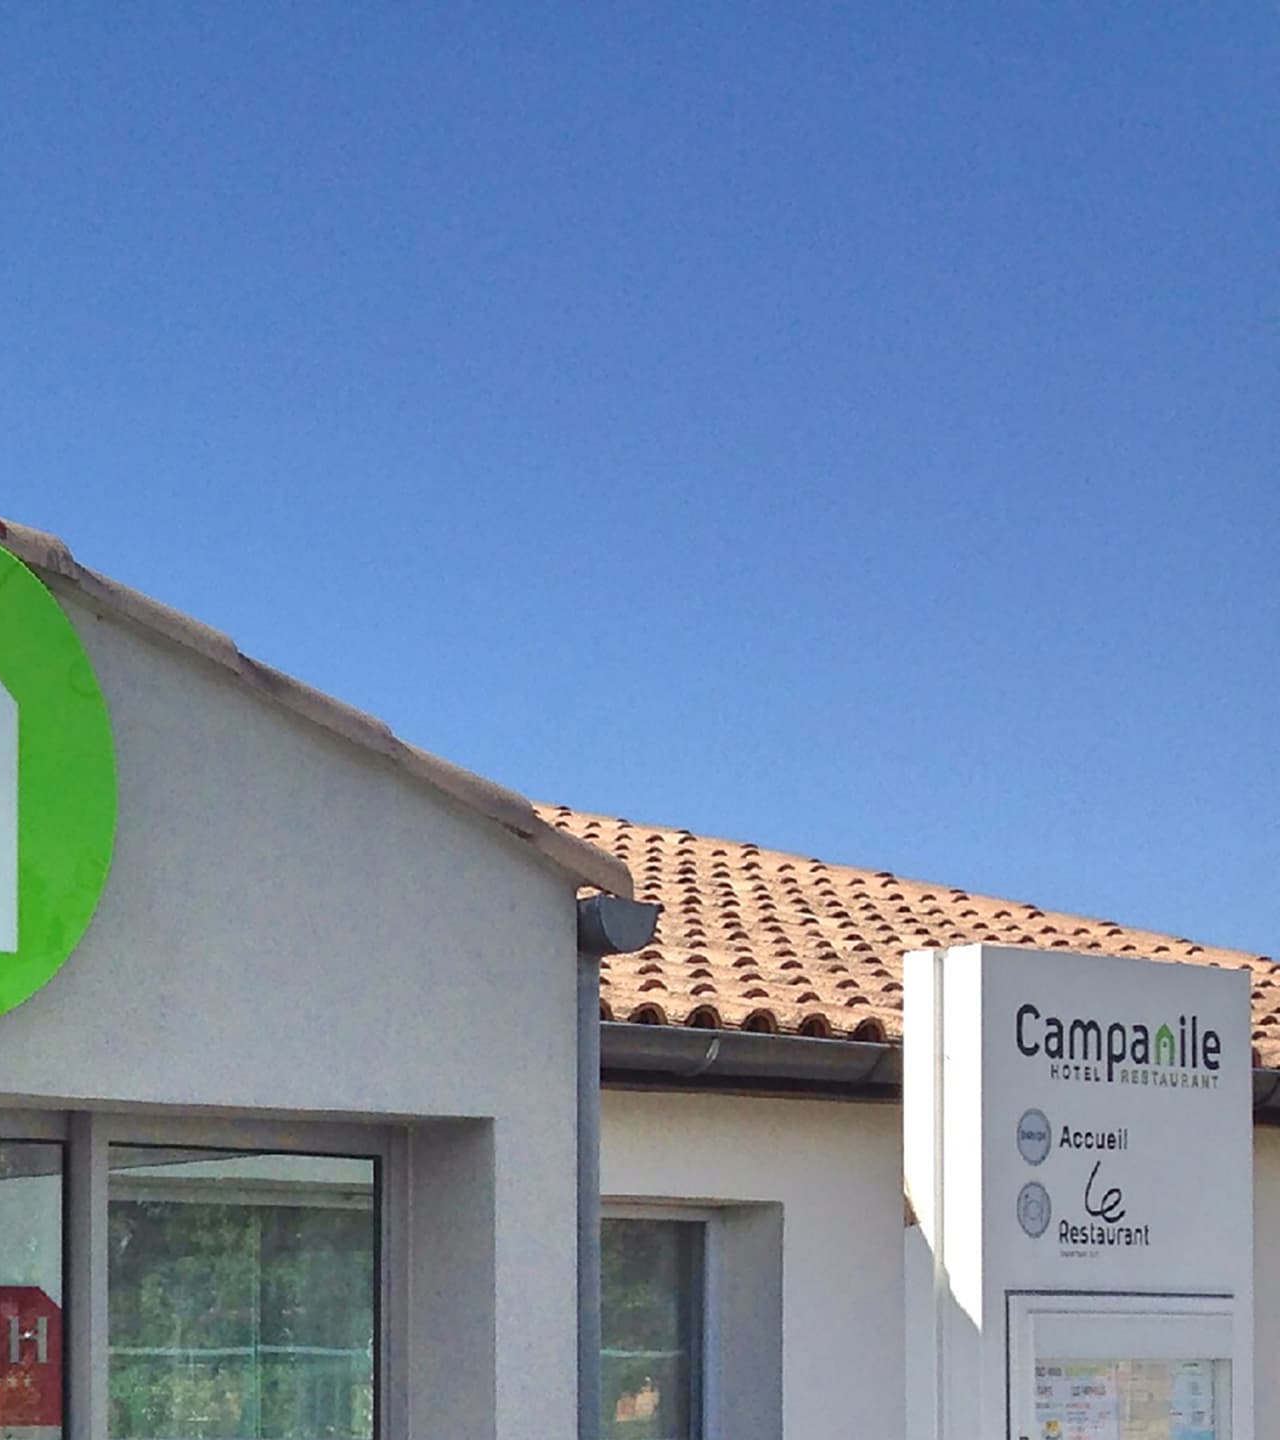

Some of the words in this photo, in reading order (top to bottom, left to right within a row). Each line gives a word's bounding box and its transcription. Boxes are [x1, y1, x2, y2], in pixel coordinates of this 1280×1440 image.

[1016, 1003, 1220, 1082] Campanile
[1050, 1064, 1101, 1082] HOTEL
[1120, 1069, 1219, 1089] RESTAURANT
[1059, 1125, 1128, 1150] Accueil
[1059, 1220, 1150, 1246] Restaurant
[9, 1315, 48, 1364] H
